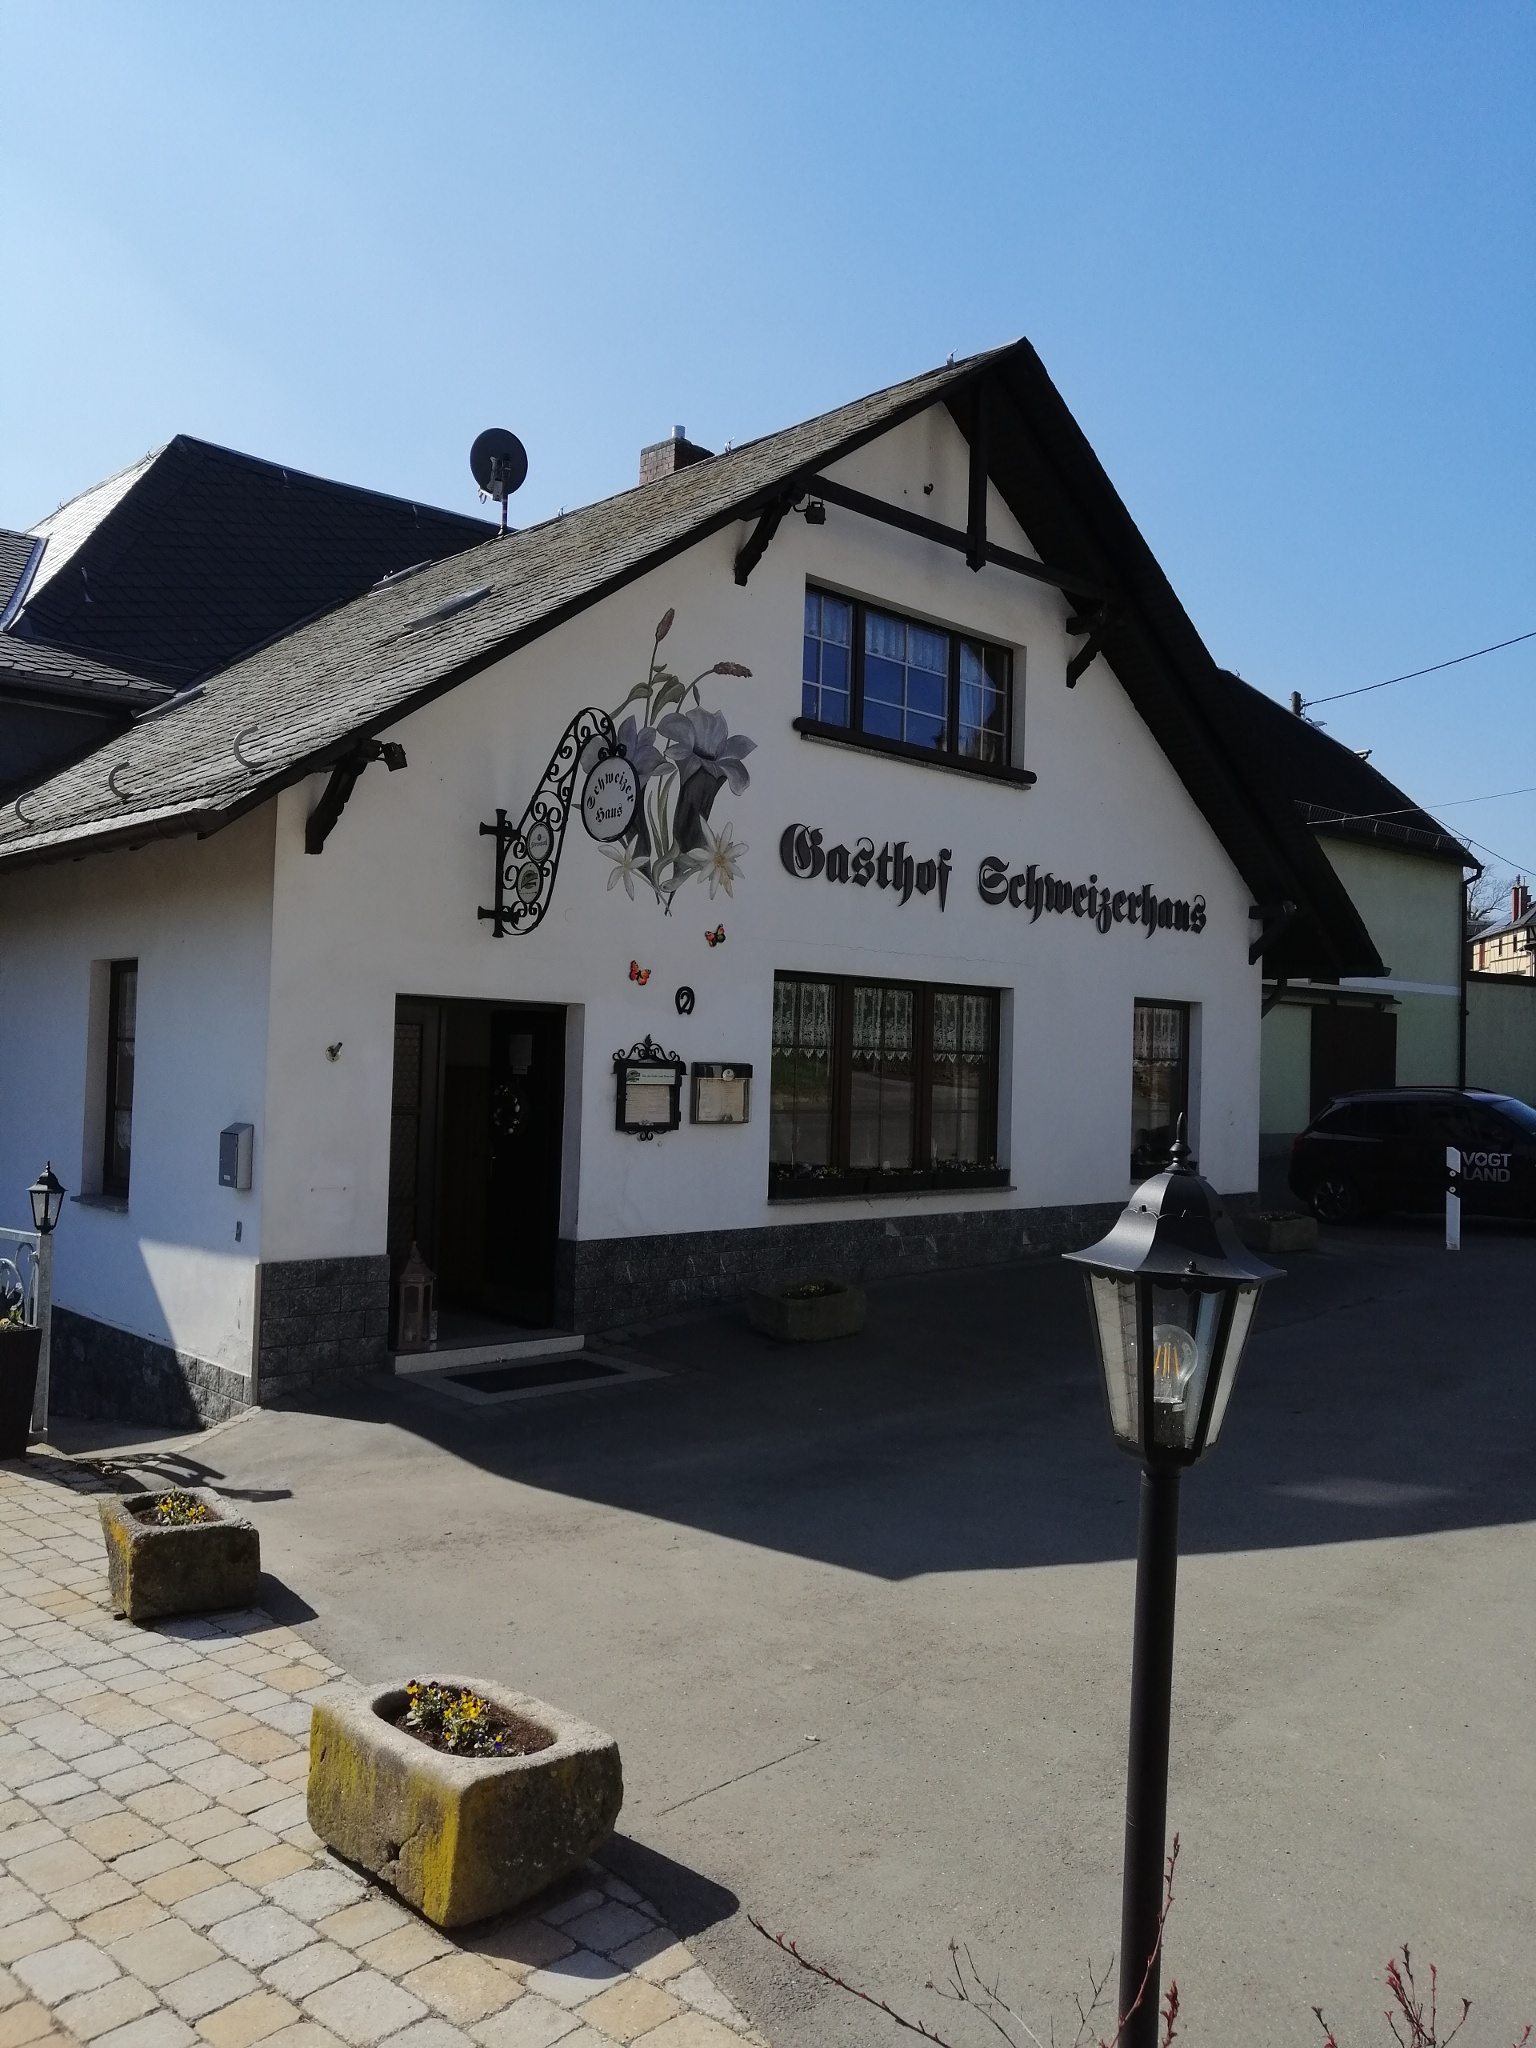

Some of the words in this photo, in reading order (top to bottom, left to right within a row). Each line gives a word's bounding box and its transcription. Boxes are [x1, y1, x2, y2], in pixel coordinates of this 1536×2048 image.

[595, 803, 623, 823] Haus
[779, 823, 953, 912] Gasthof
[976, 855, 1207, 939] Schweizerhaus
[1462, 1151, 1512, 1167] VOGT
[1463, 1166, 1511, 1183] LAND
